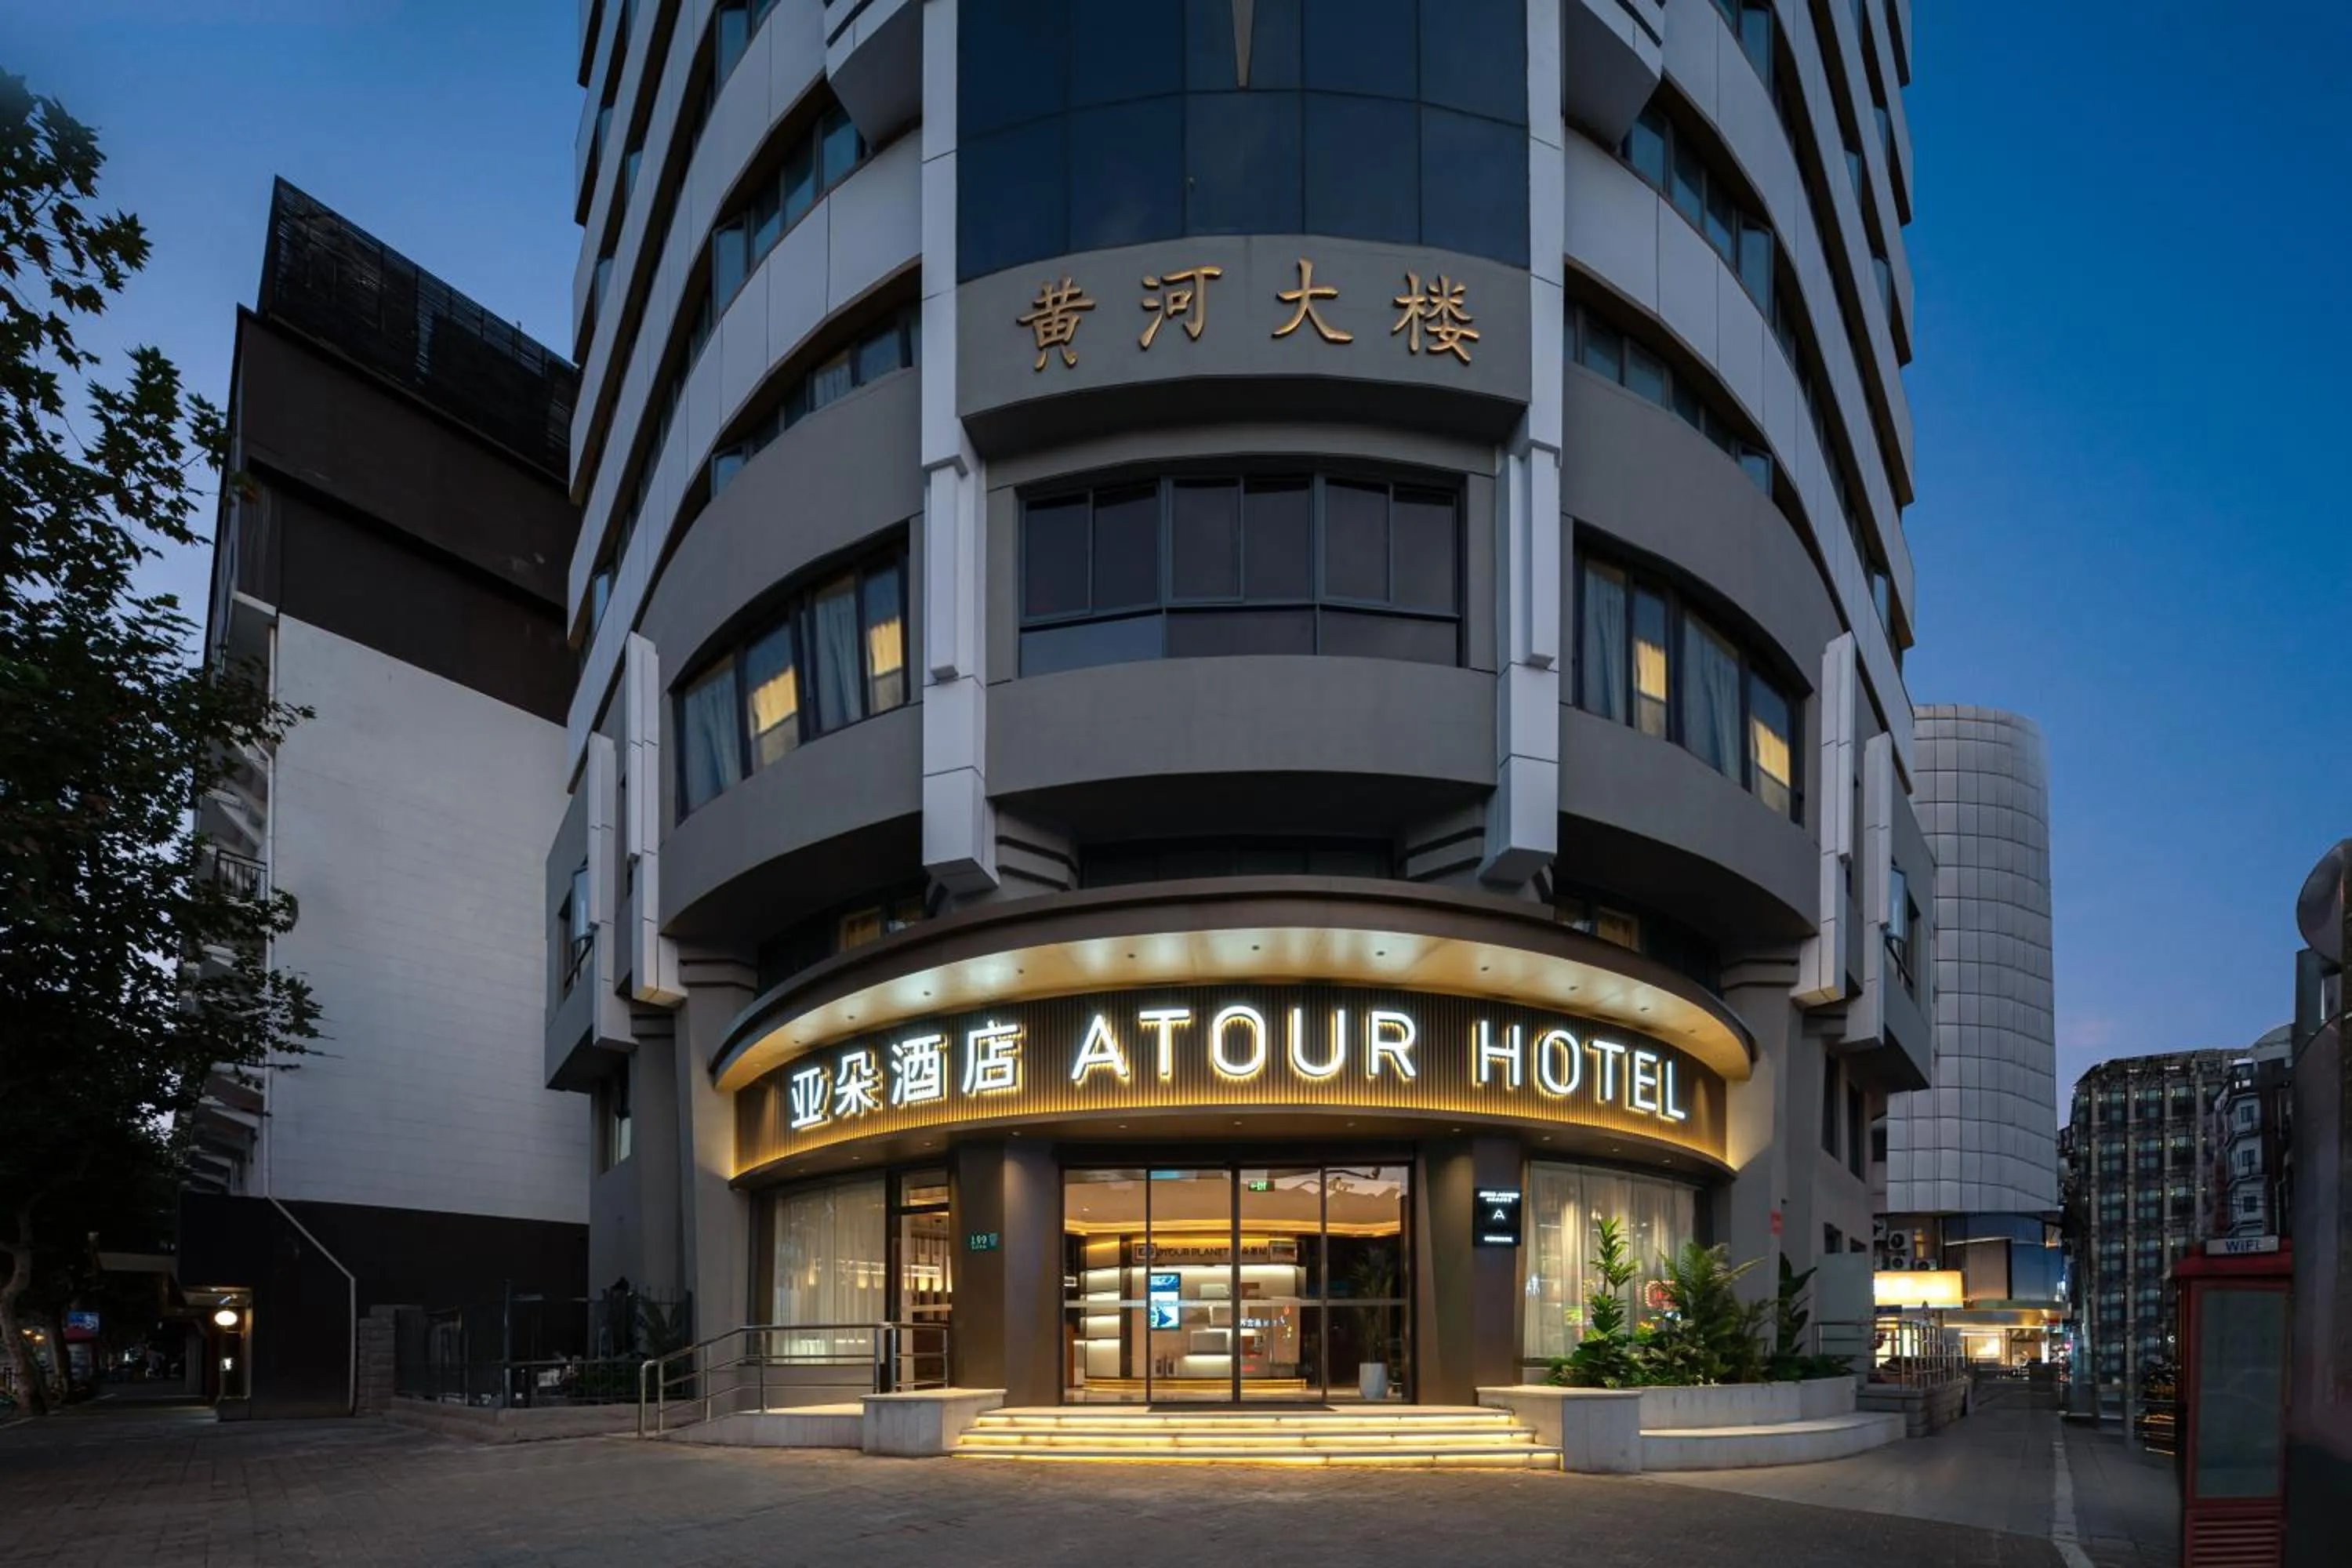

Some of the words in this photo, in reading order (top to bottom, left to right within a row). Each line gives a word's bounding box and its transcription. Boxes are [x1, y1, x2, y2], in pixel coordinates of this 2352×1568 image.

[1017, 257, 1481, 372] 黄河大楼
[790, 1020, 1020, 1130] 亚朵酒店
[1070, 1005, 1417, 1081] ATOUR
[1479, 1019, 1686, 1120] HOTEL
